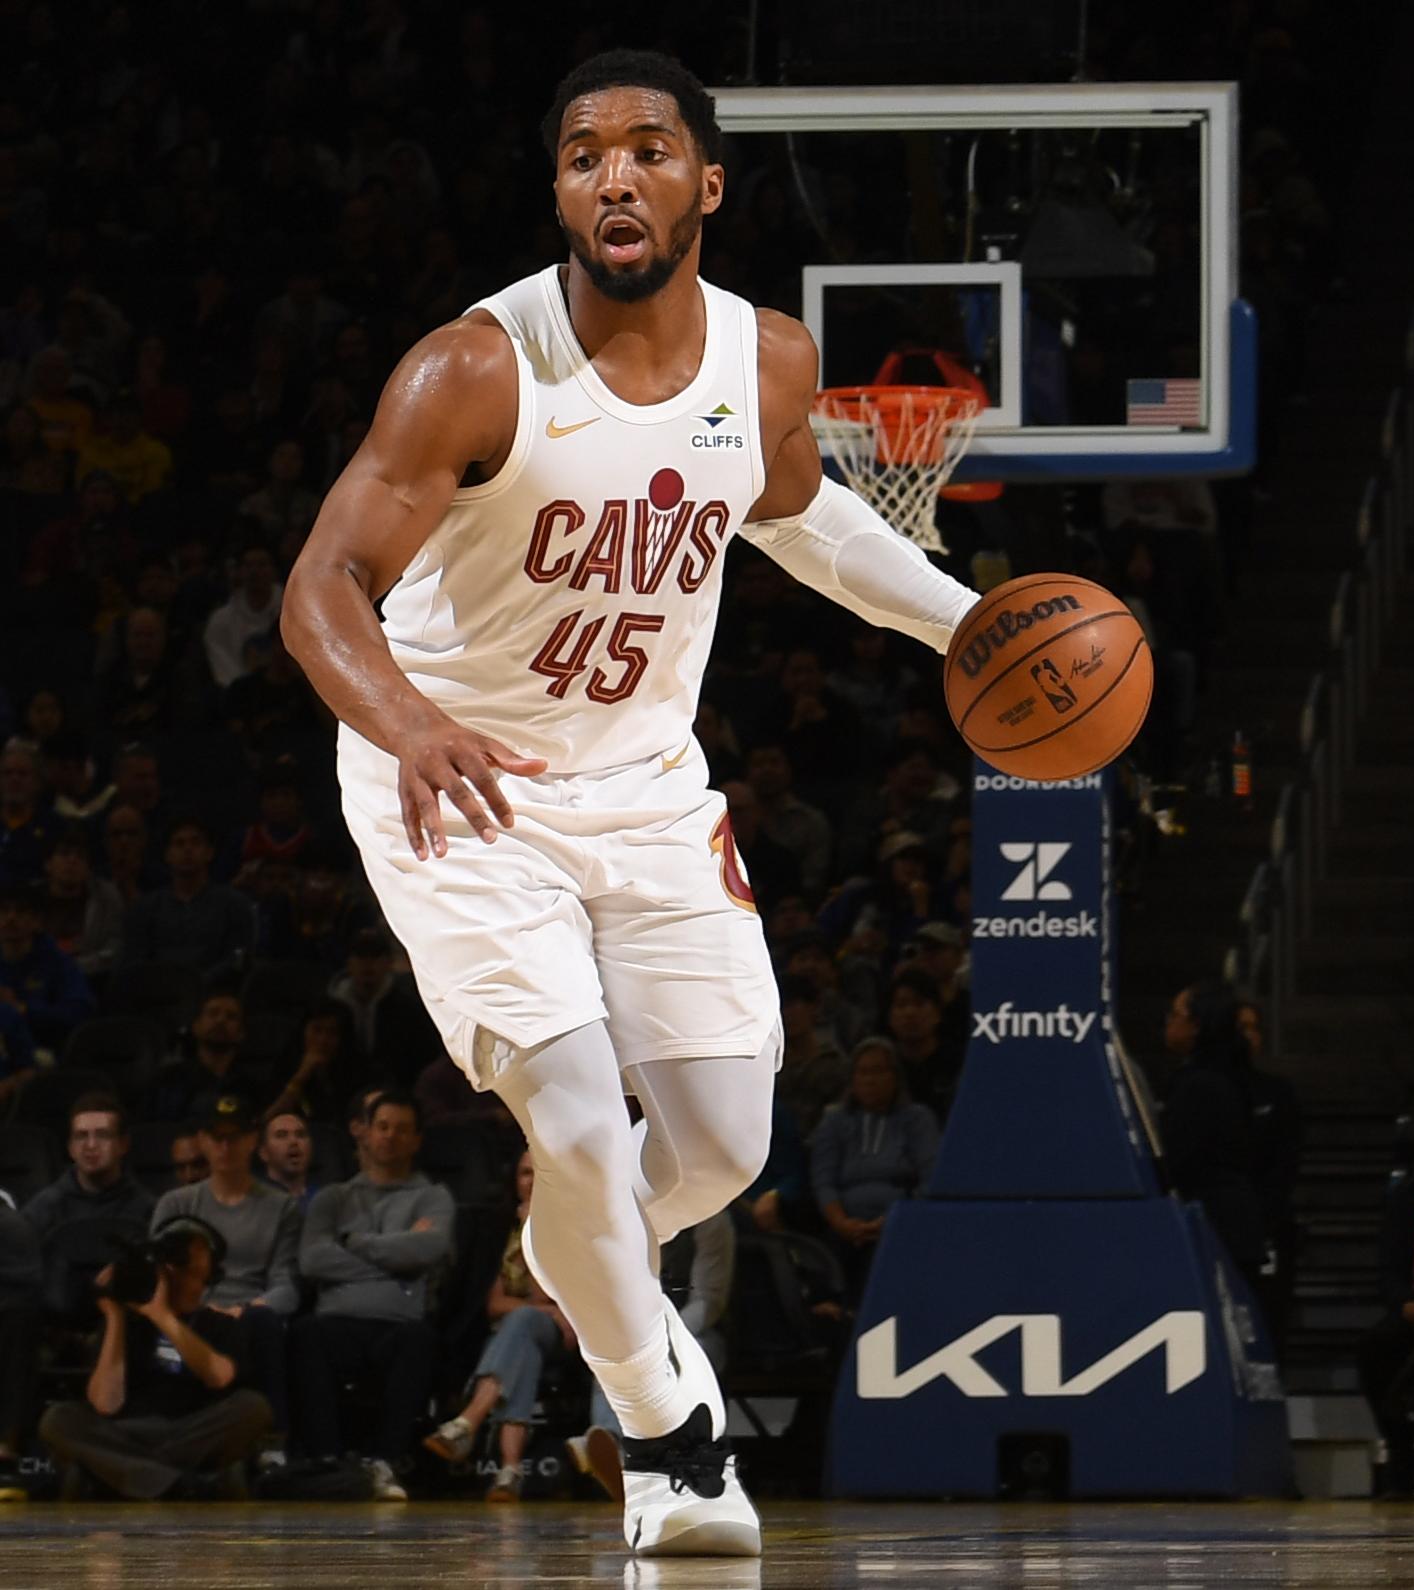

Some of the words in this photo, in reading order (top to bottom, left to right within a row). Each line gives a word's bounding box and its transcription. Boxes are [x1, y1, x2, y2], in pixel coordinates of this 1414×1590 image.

[692, 435, 743, 448] CLIFFS
[524, 498, 731, 595] CAVS
[528, 609, 666, 705] 45
[957, 594, 1081, 680] Wilson
[972, 910, 1097, 938] zendesk
[971, 1001, 1097, 1044] xfinity
